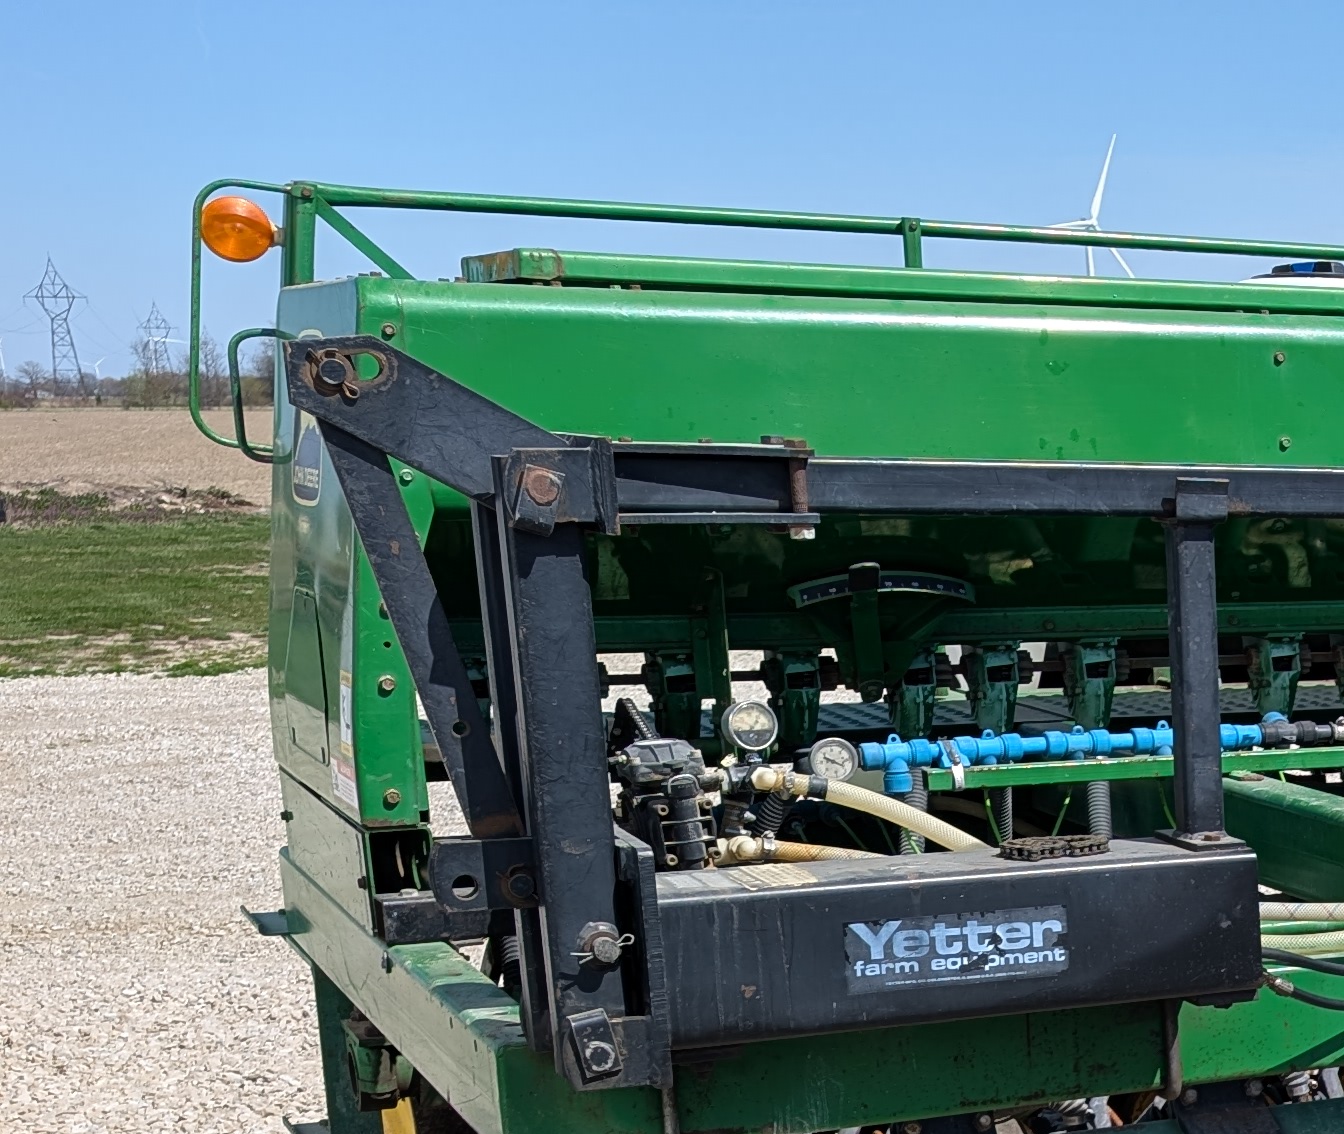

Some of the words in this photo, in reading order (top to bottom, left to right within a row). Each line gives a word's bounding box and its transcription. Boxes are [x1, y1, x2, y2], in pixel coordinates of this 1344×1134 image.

[848, 919, 1063, 961] Yetter
[854, 960, 919, 978] farm
[930, 948, 1066, 972] eqpment
